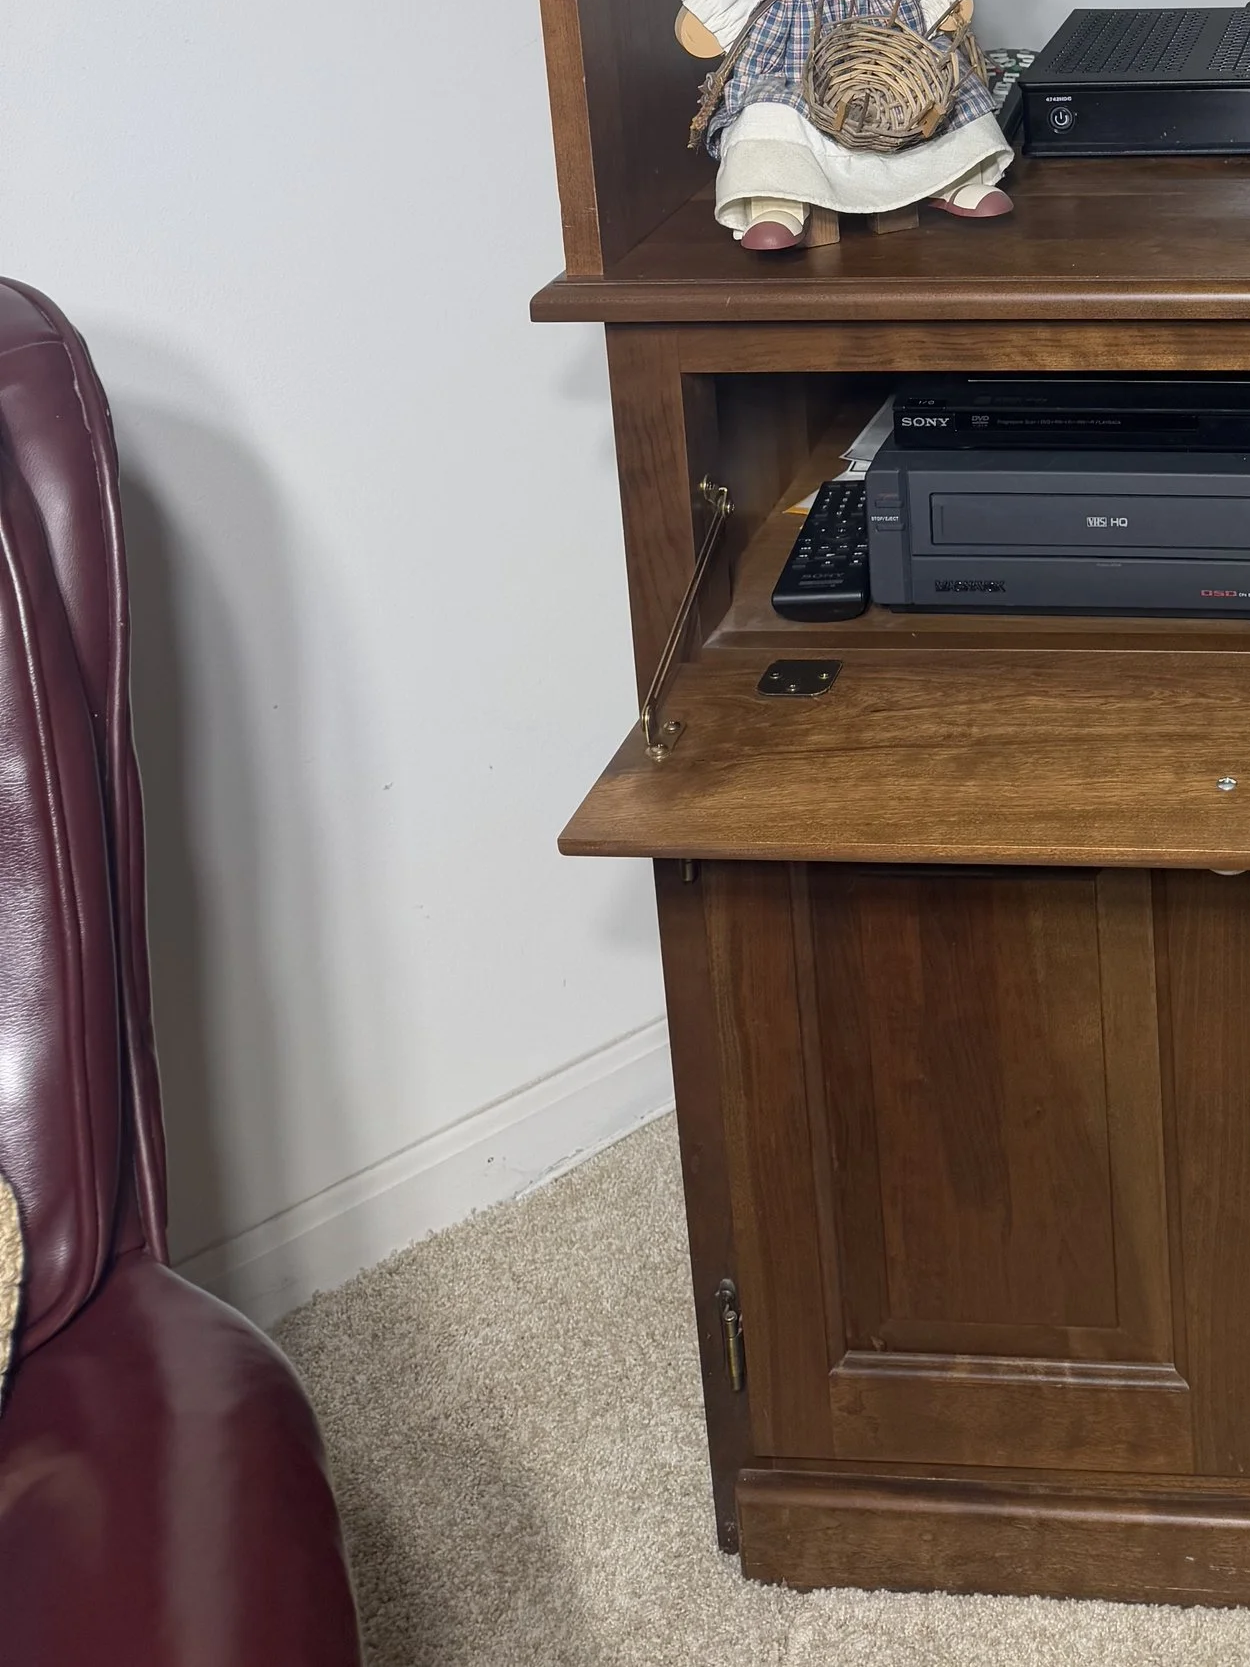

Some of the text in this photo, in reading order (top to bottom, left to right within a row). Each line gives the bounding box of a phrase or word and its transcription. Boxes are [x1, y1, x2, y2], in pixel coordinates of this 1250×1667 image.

[901, 417, 950, 427] SONY
[1086, 516, 1128, 527] VHS HQ
[1200, 589, 1238, 597] OSD
